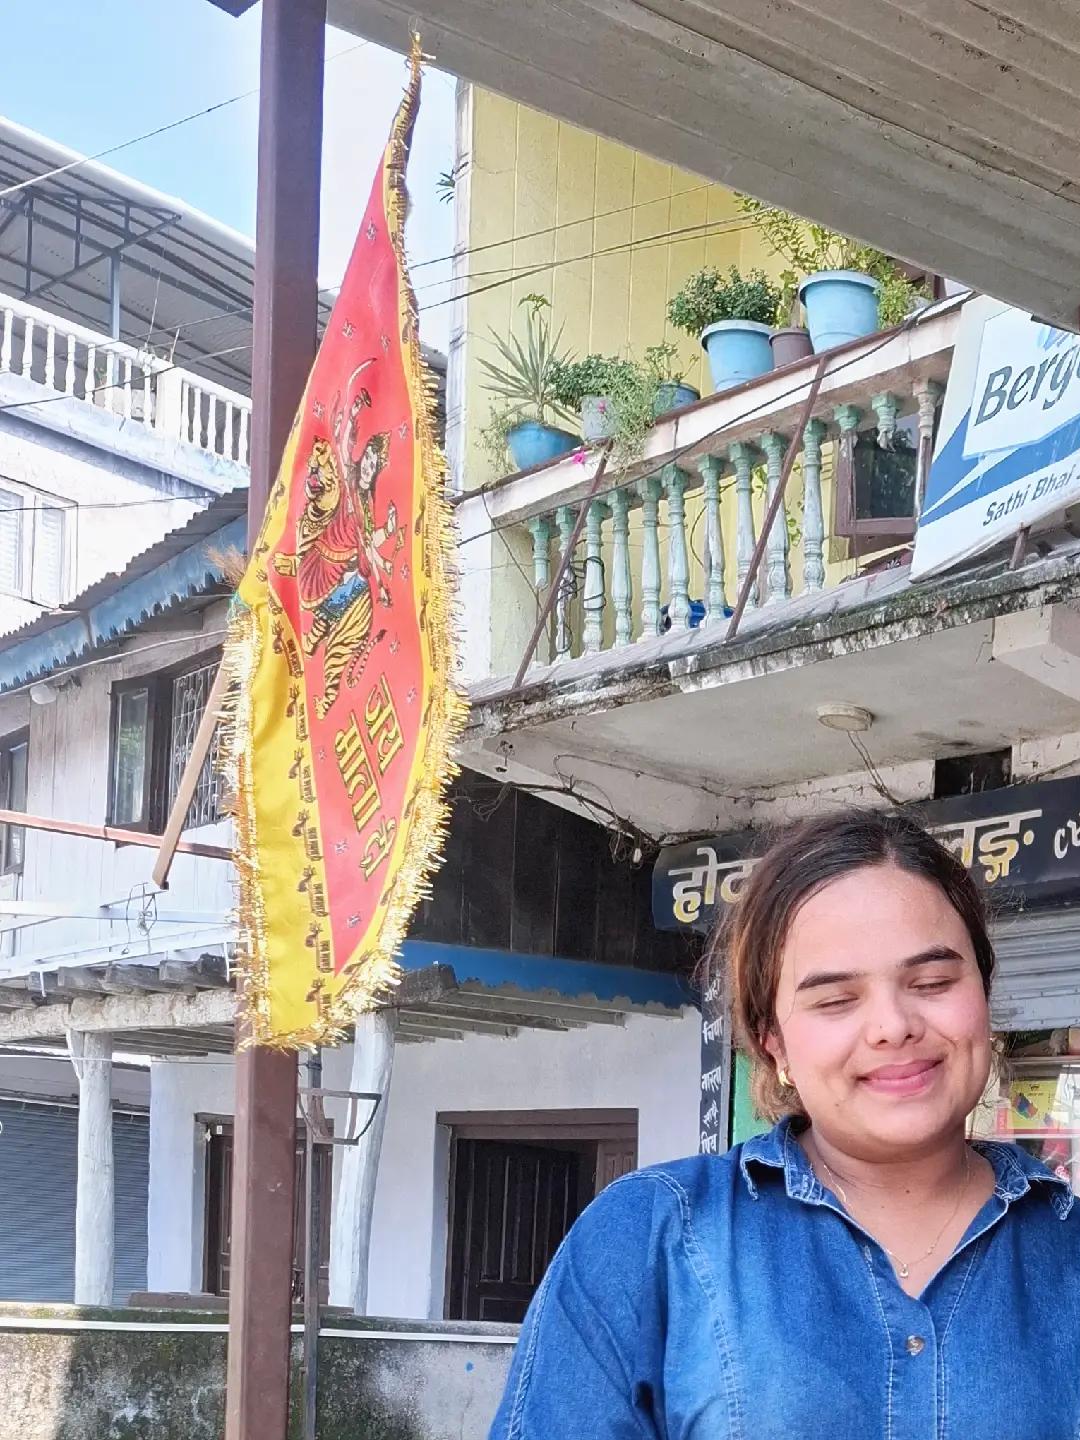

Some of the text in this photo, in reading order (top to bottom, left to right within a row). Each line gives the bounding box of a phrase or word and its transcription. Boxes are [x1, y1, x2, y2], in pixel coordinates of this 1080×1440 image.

[983, 484, 1031, 526] Sathi
[1031, 466, 1076, 500] Bhai
[668, 847, 763, 923] होट
